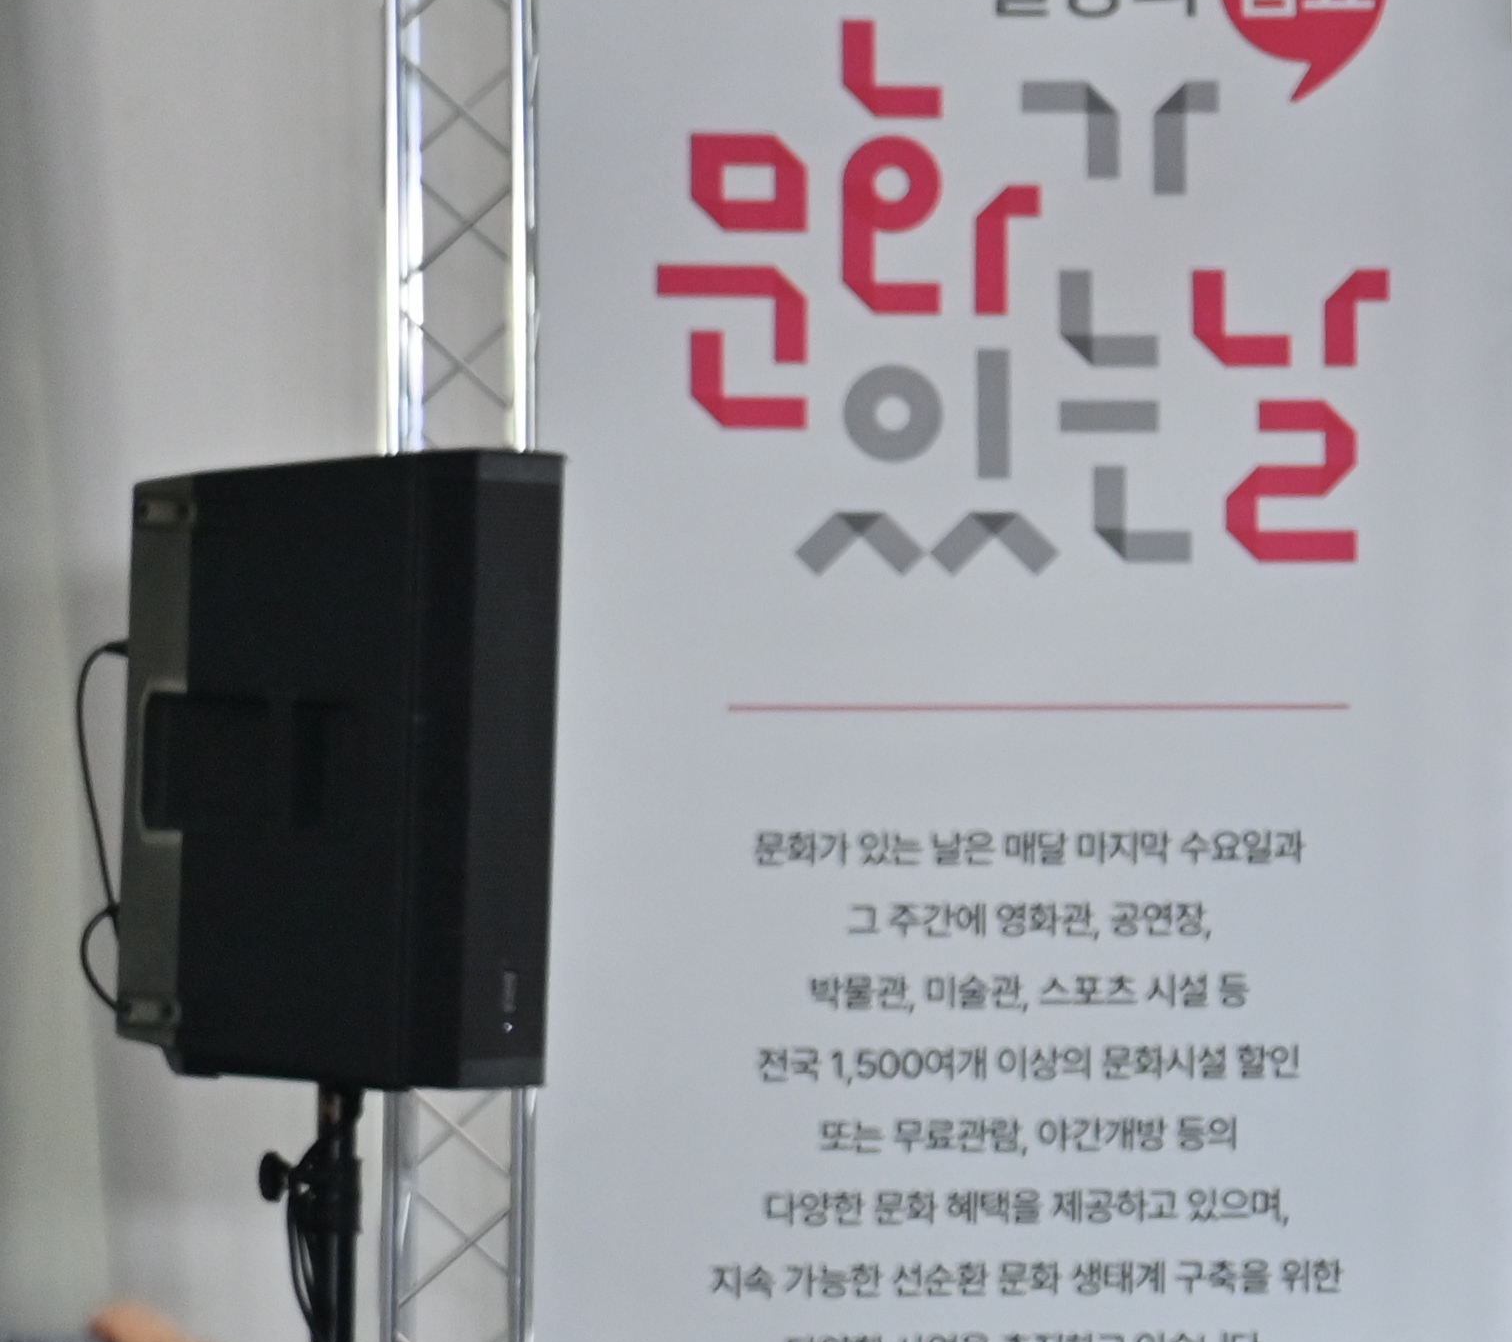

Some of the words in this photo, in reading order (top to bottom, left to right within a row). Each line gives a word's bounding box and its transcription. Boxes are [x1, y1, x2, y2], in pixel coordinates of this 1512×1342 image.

[656, 19, 1219, 430] 문화가
[1192, 269, 1390, 563] 날
[754, 830, 850, 867] 문화가
[857, 830, 924, 867] 있는
[930, 830, 996, 867] 날은
[1003, 830, 1069, 867] 매달
[1075, 829, 1172, 866] 마지막
[1179, 829, 1306, 866] 수요일과
[847, 903, 880, 935] 그
[887, 902, 987, 938] 주간에
[994, 901, 1100, 942] 영화관,
[1109, 901, 1212, 942] 공연장,
[807, 973, 915, 1015] 박물관,
[923, 973, 1029, 1014] 미술관,
[1039, 974, 1138, 1008] 스포츠
[1145, 972, 1208, 1009] 시설
[1217, 972, 1250, 1009] 등
[756, 1046, 822, 1083] 전국
[830, 1045, 987, 1088] 1,500여개
[996, 1045, 1091, 1082] 이상의
[1101, 1044, 1227, 1081] 문화시설
[1237, 1043, 1299, 1080] 할인
[819, 1117, 884, 1155] 또는
[892, 1115, 1028, 1157] 무료관람,
[1036, 1116, 1167, 1153] 야간개방
[1175, 1115, 1237, 1152] 등의
[762, 1190, 863, 1228] 다양한
[874, 1190, 938, 1226] 문화
[945, 1188, 1042, 1225] 혜택을
[1050, 1188, 1178, 1225] 제공하고
[1186, 1187, 1289, 1228] 있으며,
[709, 1263, 776, 1300] 지속
[783, 1262, 882, 1299] 가능한
[891, 1261, 989, 1298] 선순환
[997, 1260, 1061, 1297] 문화
[1069, 1259, 1166, 1297] 생태계
[1174, 1258, 1272, 1296] 구축을
[1280, 1258, 1344, 1294] 위한
